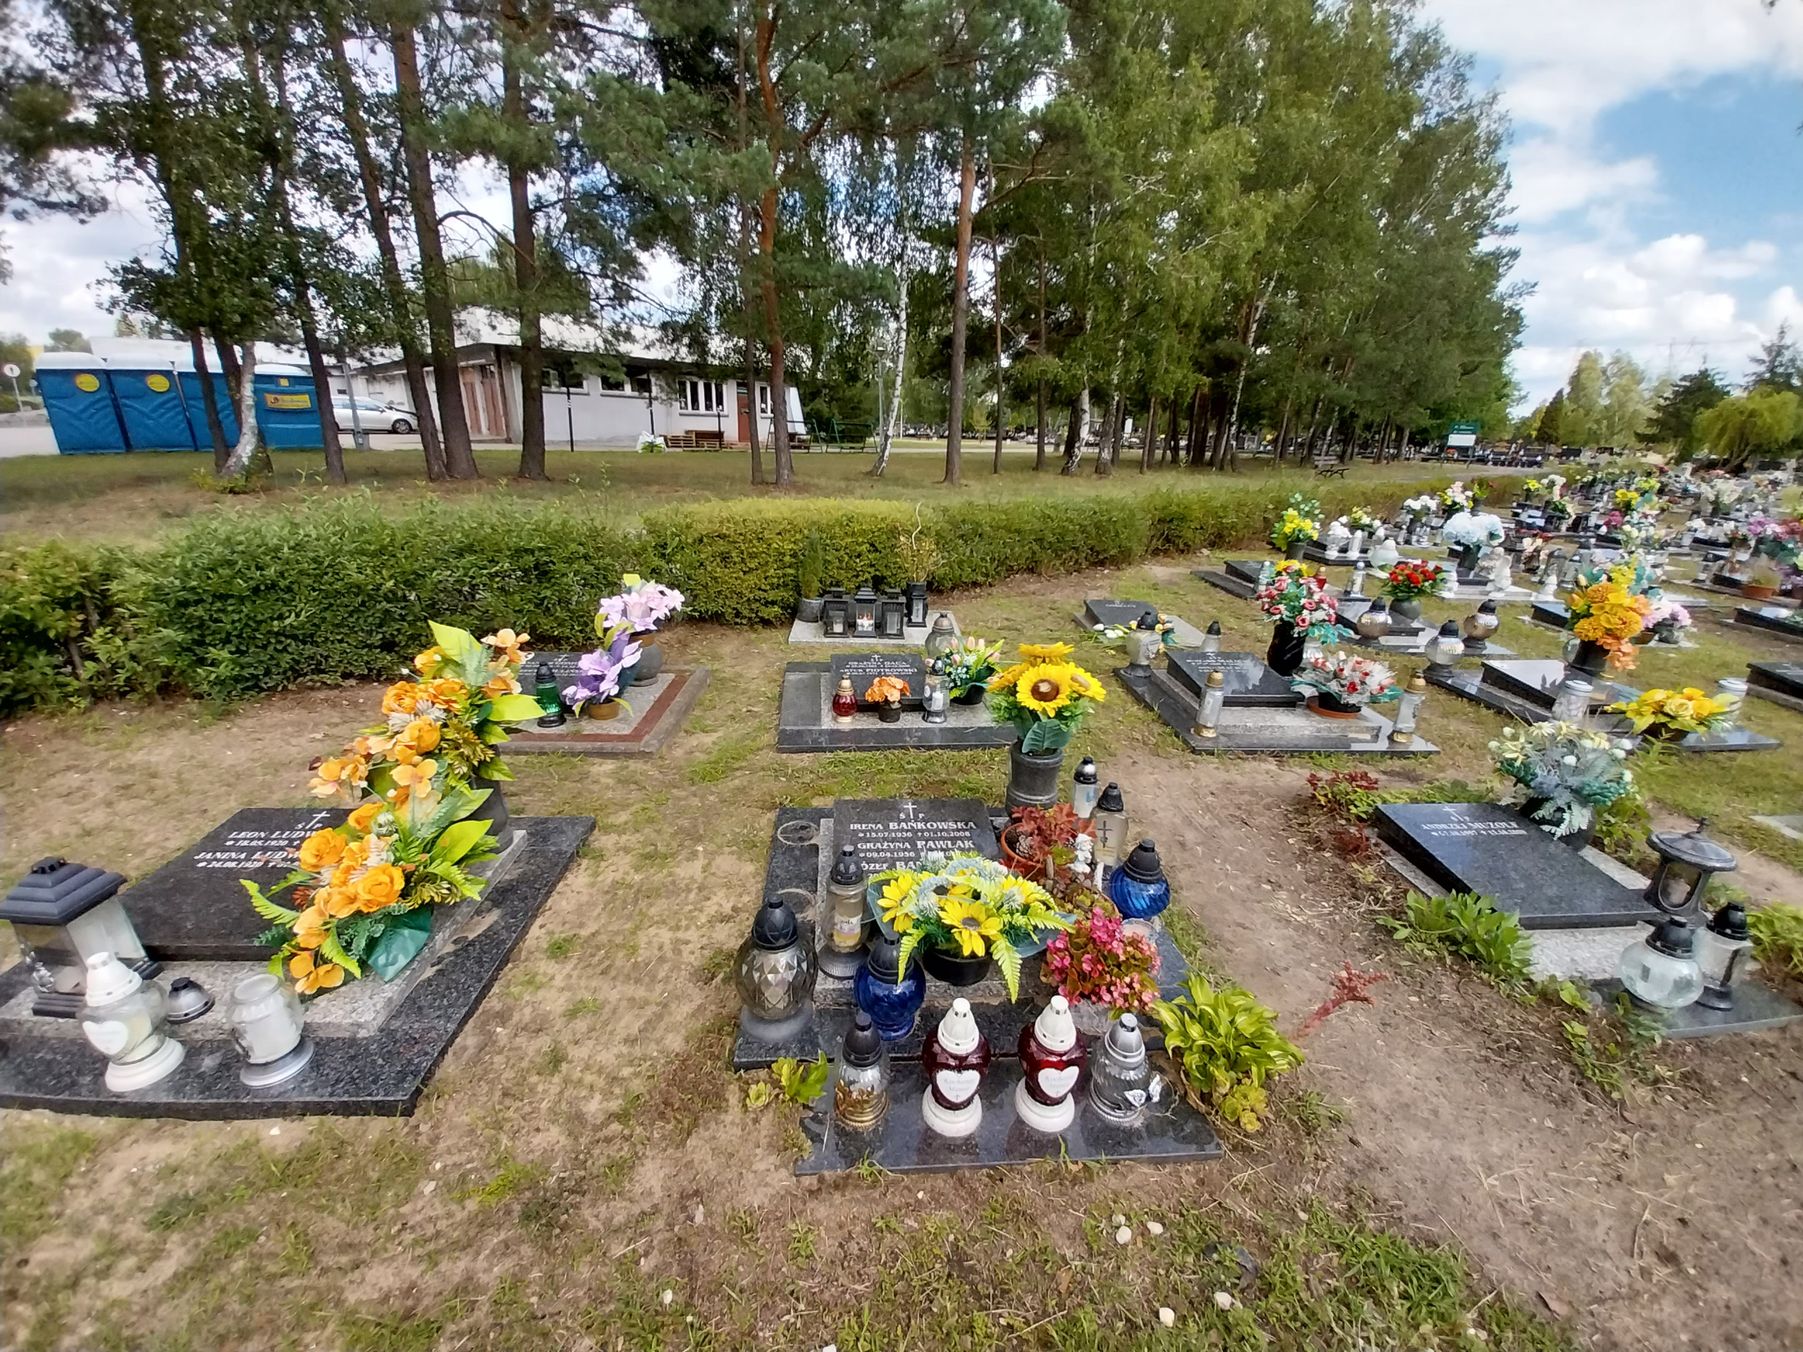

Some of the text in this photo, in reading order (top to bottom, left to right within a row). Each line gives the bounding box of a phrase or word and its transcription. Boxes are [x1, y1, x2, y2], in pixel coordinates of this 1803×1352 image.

[850, 820, 977, 830] IRENA BAŃKOWSKA
[228, 830, 317, 839] LEON LUDW
[857, 840, 975, 850] GRAŻYNA PAWLAK
[193, 850, 301, 860] JANINA LUDW
[861, 860, 889, 870] ÓZEF
